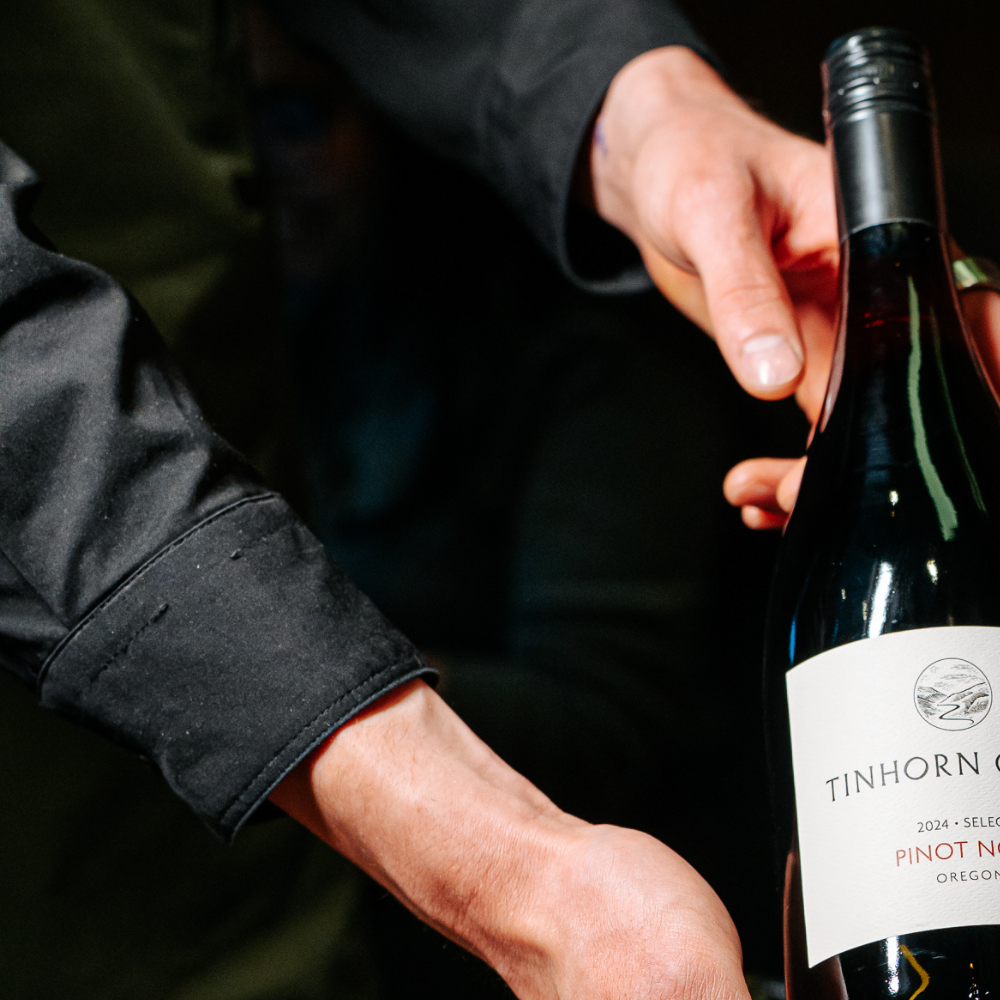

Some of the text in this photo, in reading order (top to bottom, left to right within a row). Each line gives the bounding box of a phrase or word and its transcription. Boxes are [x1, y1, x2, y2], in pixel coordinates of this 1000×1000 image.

[825, 751, 981, 802] TINHORN
[917, 818, 949, 833] 2024
[895, 840, 968, 867] PINOT
